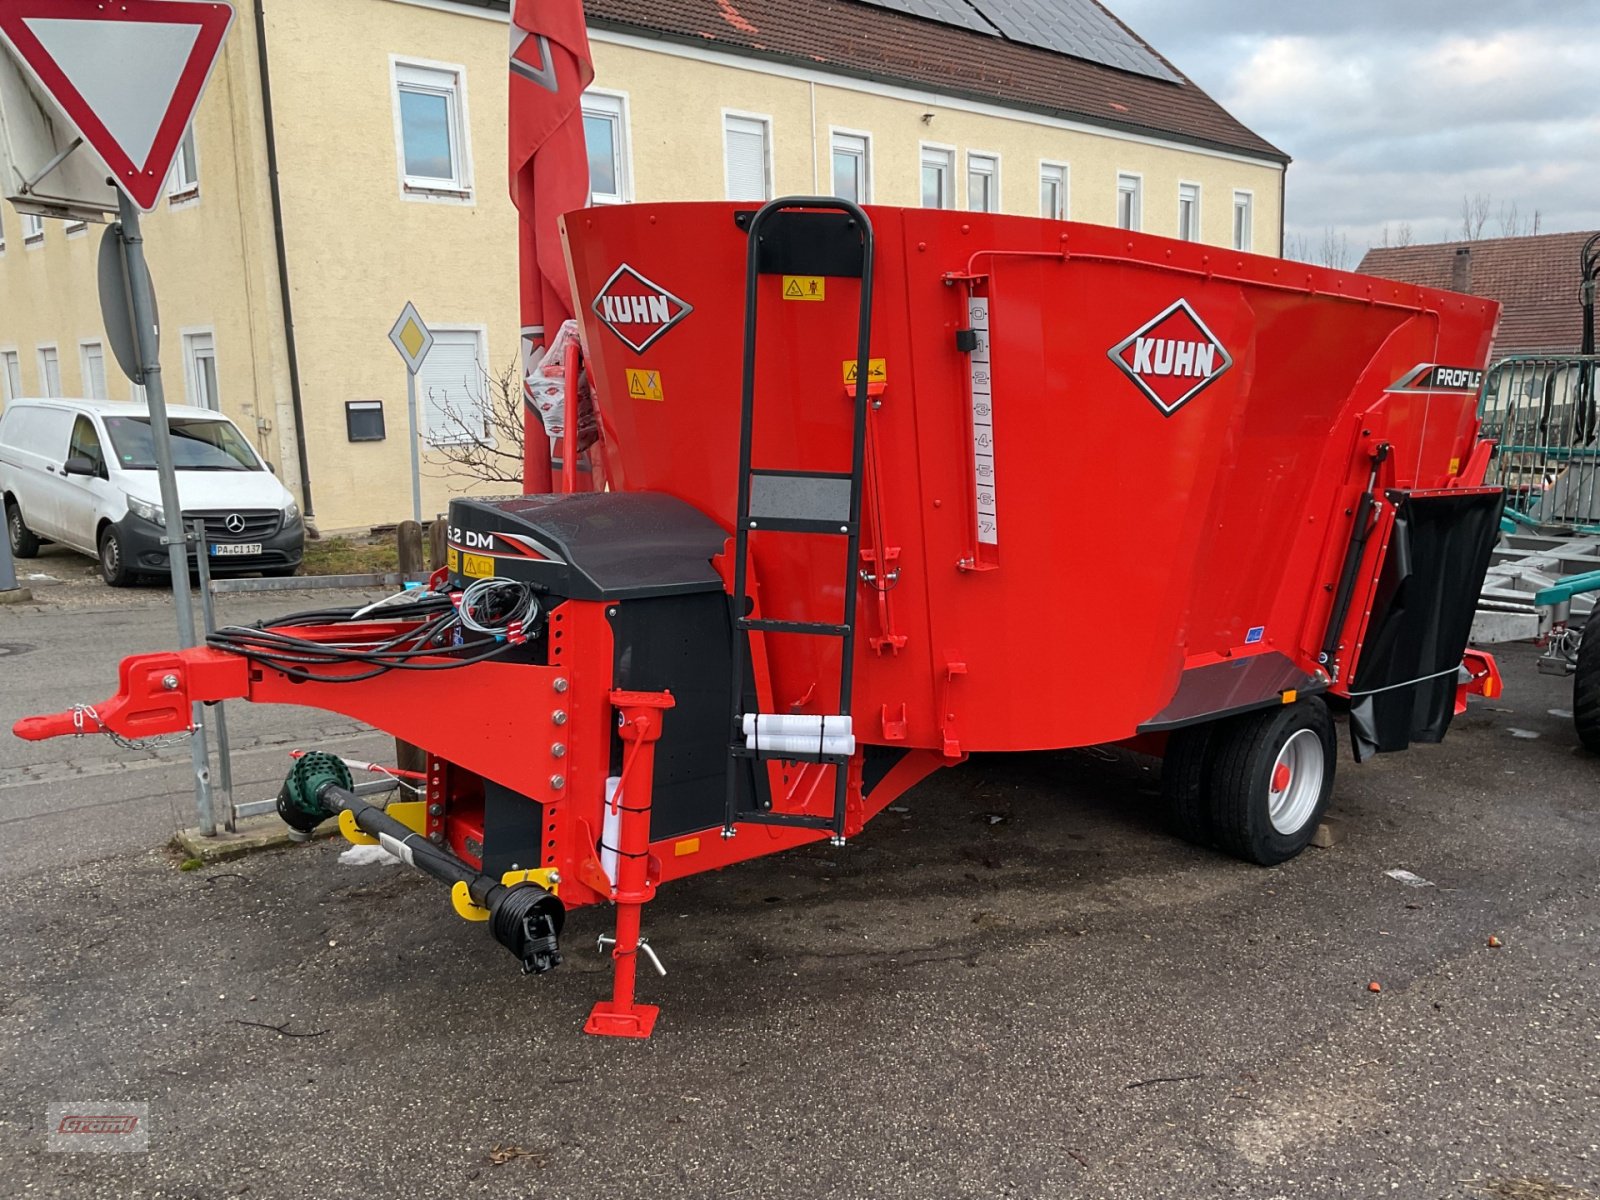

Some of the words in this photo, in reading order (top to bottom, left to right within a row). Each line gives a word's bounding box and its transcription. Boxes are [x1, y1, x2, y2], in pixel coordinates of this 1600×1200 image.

[602, 295, 670, 323] KUHN
[971, 307, 985, 320] 0
[1133, 337, 1215, 377] KUHN
[974, 371, 988, 385] 2
[1436, 368, 1482, 388] PROFILE
[976, 403, 989, 416] 3
[978, 433, 989, 448] 4
[978, 464, 991, 477] 5
[979, 493, 992, 505] 6
[980, 521, 993, 533] 7
[466, 531, 494, 549] DM
[217, 545, 228, 554] PA
[247, 544, 260, 553] 137
